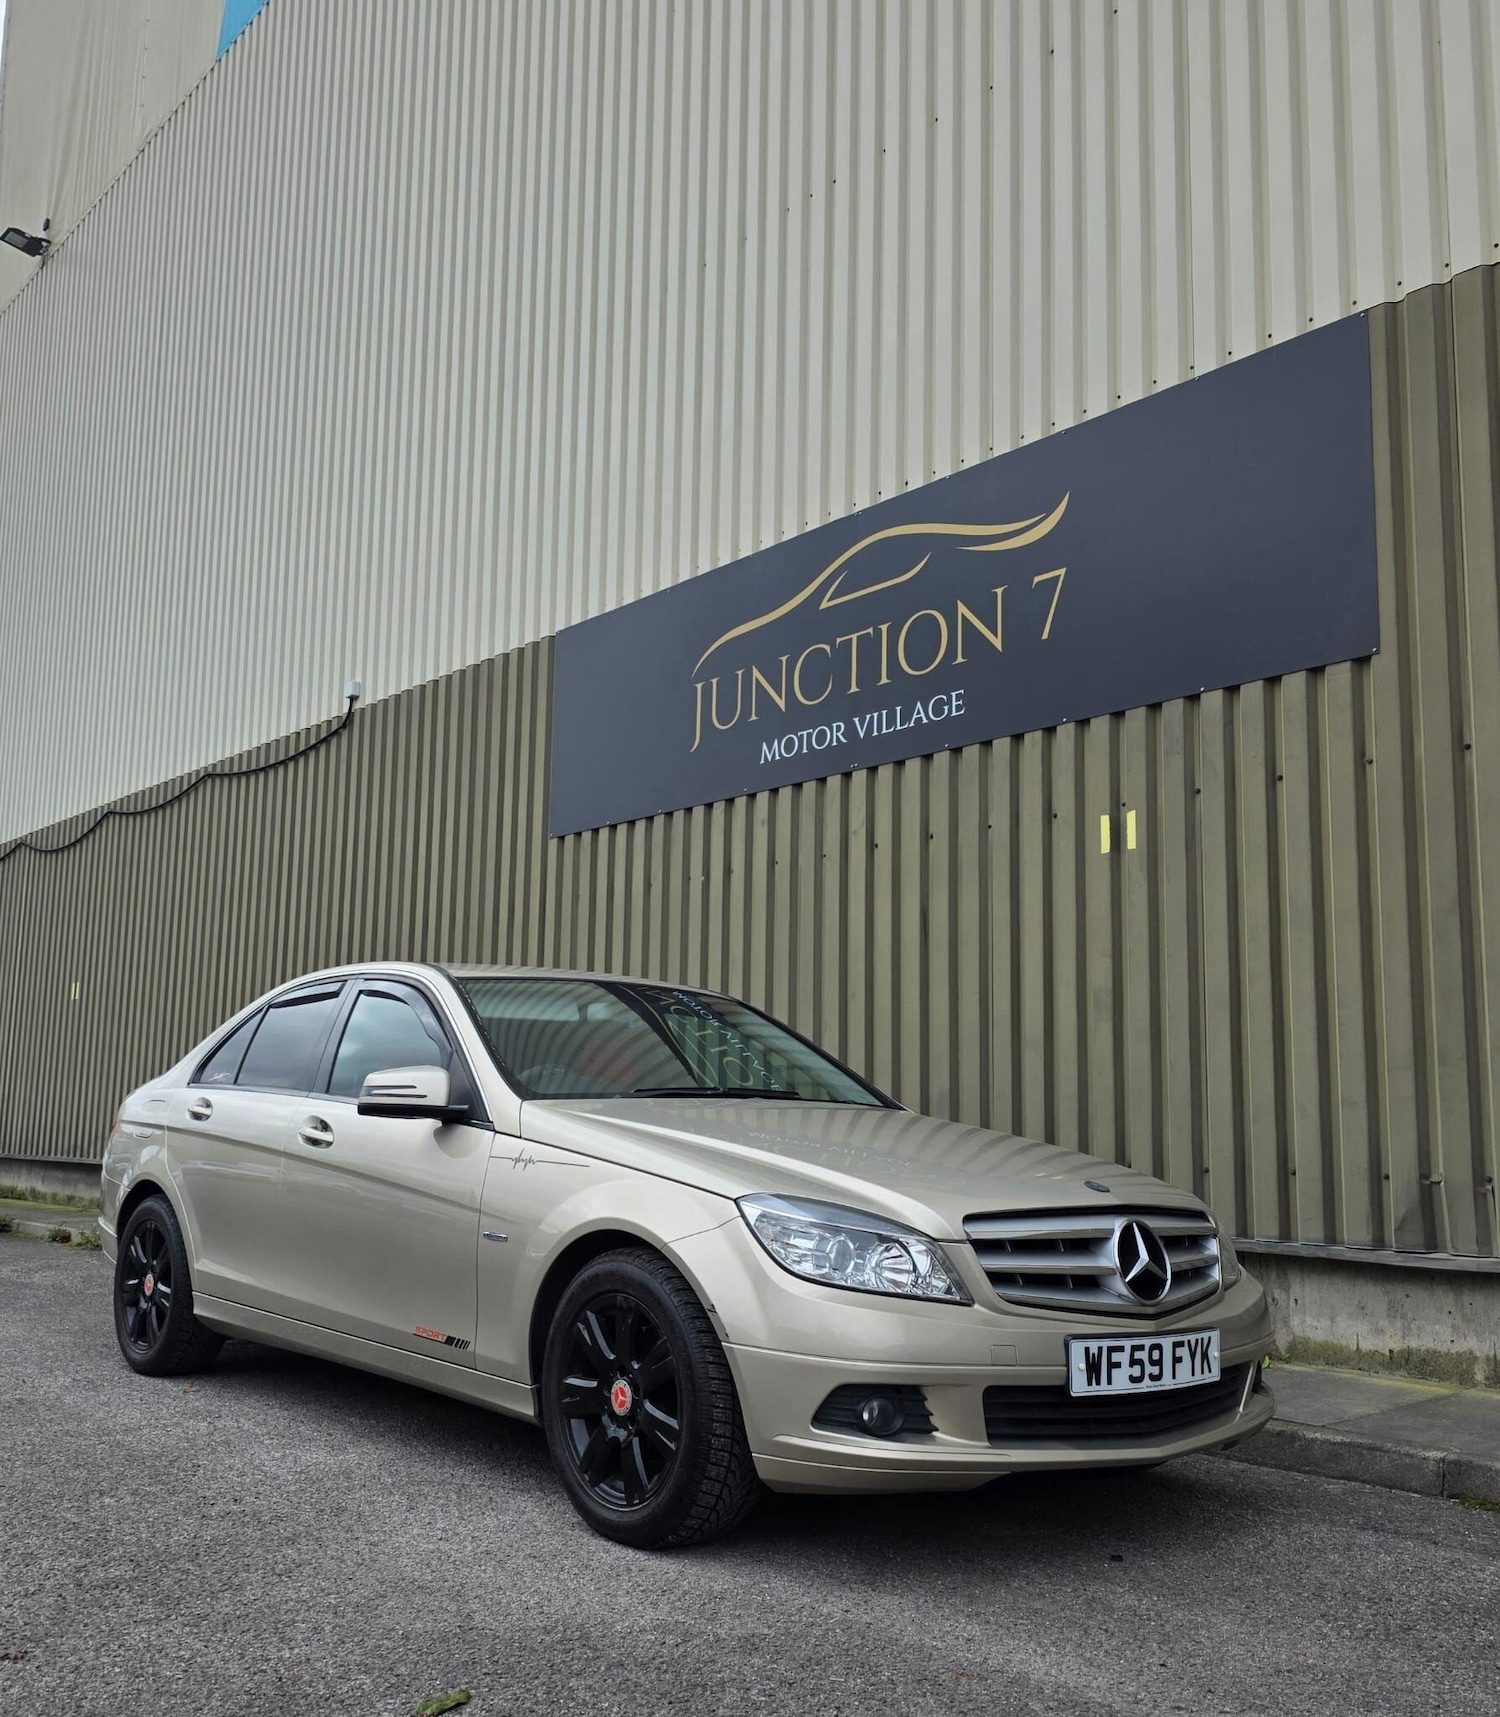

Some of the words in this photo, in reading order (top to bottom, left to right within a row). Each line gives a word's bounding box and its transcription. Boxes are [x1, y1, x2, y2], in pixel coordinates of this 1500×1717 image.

[689, 585, 1008, 752] JUNCTION
[1031, 567, 1067, 640] 7
[758, 721, 848, 764] MOTOR
[852, 689, 966, 740] VILLAGE
[415, 1326, 446, 1341] SPORT
[1084, 1342, 1164, 1387] WF59
[1171, 1336, 1212, 1380] FYK
